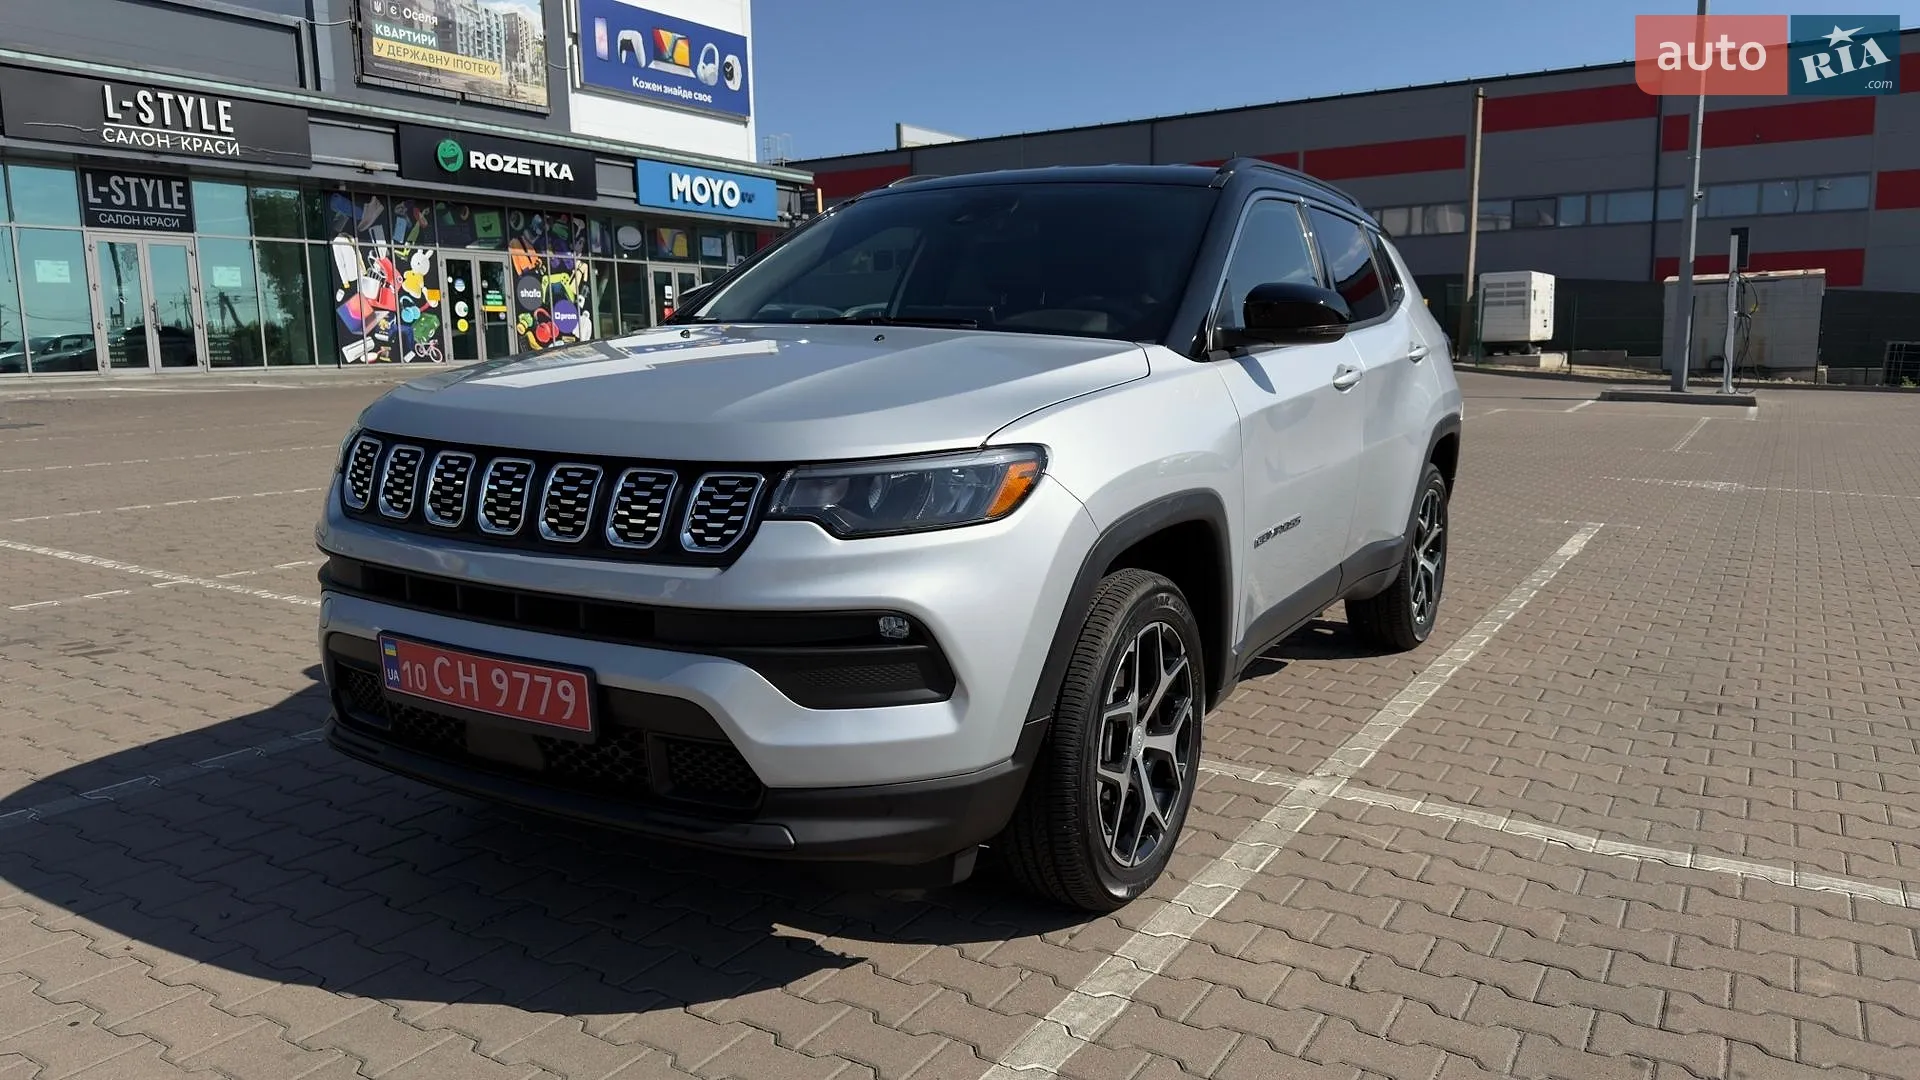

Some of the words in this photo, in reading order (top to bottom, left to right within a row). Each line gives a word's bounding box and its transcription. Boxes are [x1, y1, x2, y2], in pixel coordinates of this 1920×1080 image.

[403, 7, 438, 26] Оселя
[375, 23, 437, 47] КВАРТИРИ
[376, 41, 384, 53] У
[386, 44, 450, 66] ДЕРЖАВНУ
[452, 58, 498, 77] ІПОТЕКУ
[632, 76, 663, 93] Кожен
[663, 84, 693, 100] знайде
[693, 91, 713, 104] своє
[104, 85, 234, 132] L-STYLE
[103, 128, 170, 148] САЛОН
[181, 137, 240, 156] КРАСИ
[469, 150, 574, 182] ROZETKA
[86, 173, 186, 210] L-STYLE
[670, 172, 740, 208] MOYO
[98, 213, 141, 227] САЛОН
[142, 214, 180, 228] КРАСИ
[520, 288, 541, 298] shafa
[387, 668, 400, 682] UA
[402, 660, 428, 692] 10
[433, 656, 479, 701] CH
[490, 668, 576, 720] 9779
